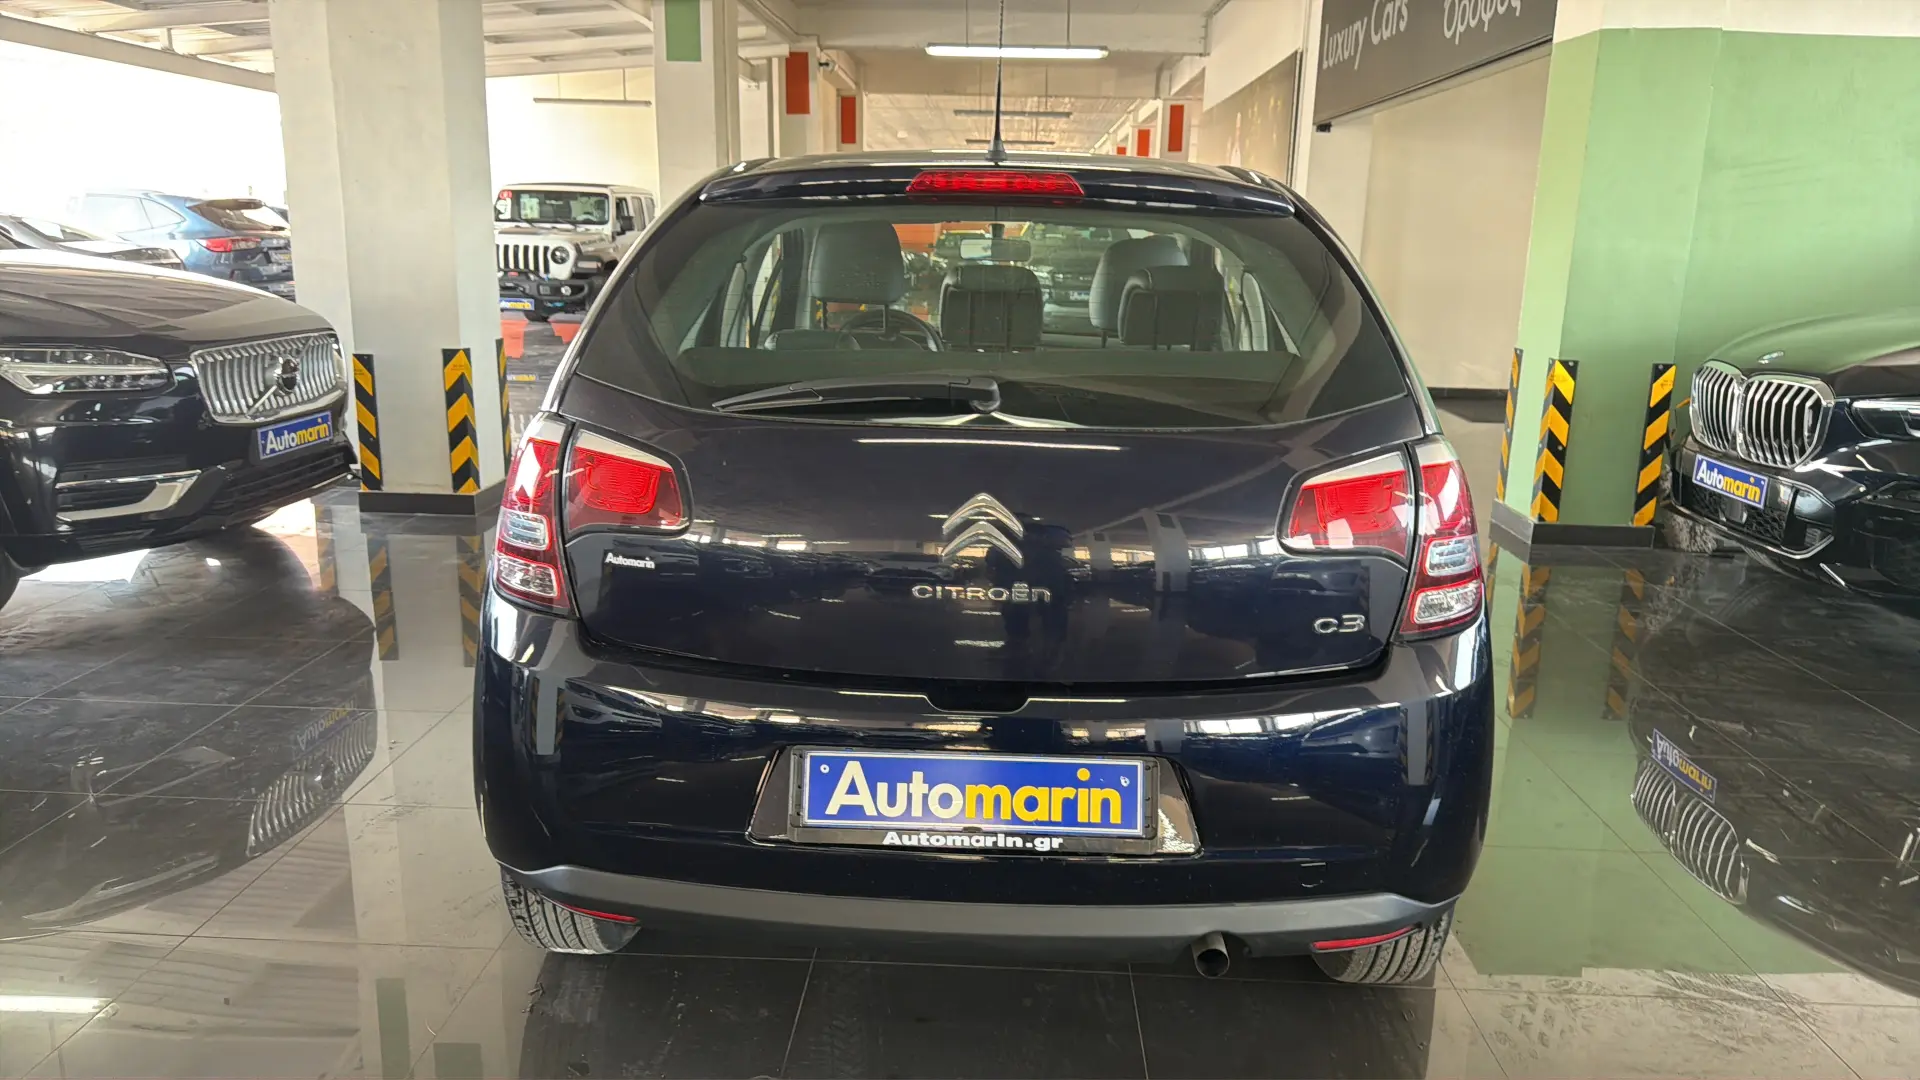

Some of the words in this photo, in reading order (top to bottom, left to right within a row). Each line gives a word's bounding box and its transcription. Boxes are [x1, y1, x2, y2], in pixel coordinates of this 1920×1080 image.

[1322, 16, 1367, 71] Luxury
[1371, 0, 1408, 45] Cars
[265, 417, 329, 454] Automarin
[1696, 460, 1760, 502] Automarin
[605, 552, 655, 569] Automarin
[1314, 614, 1365, 633] C3
[825, 760, 1121, 824] Automarin
[882, 832, 1064, 851] Automarin.gr
